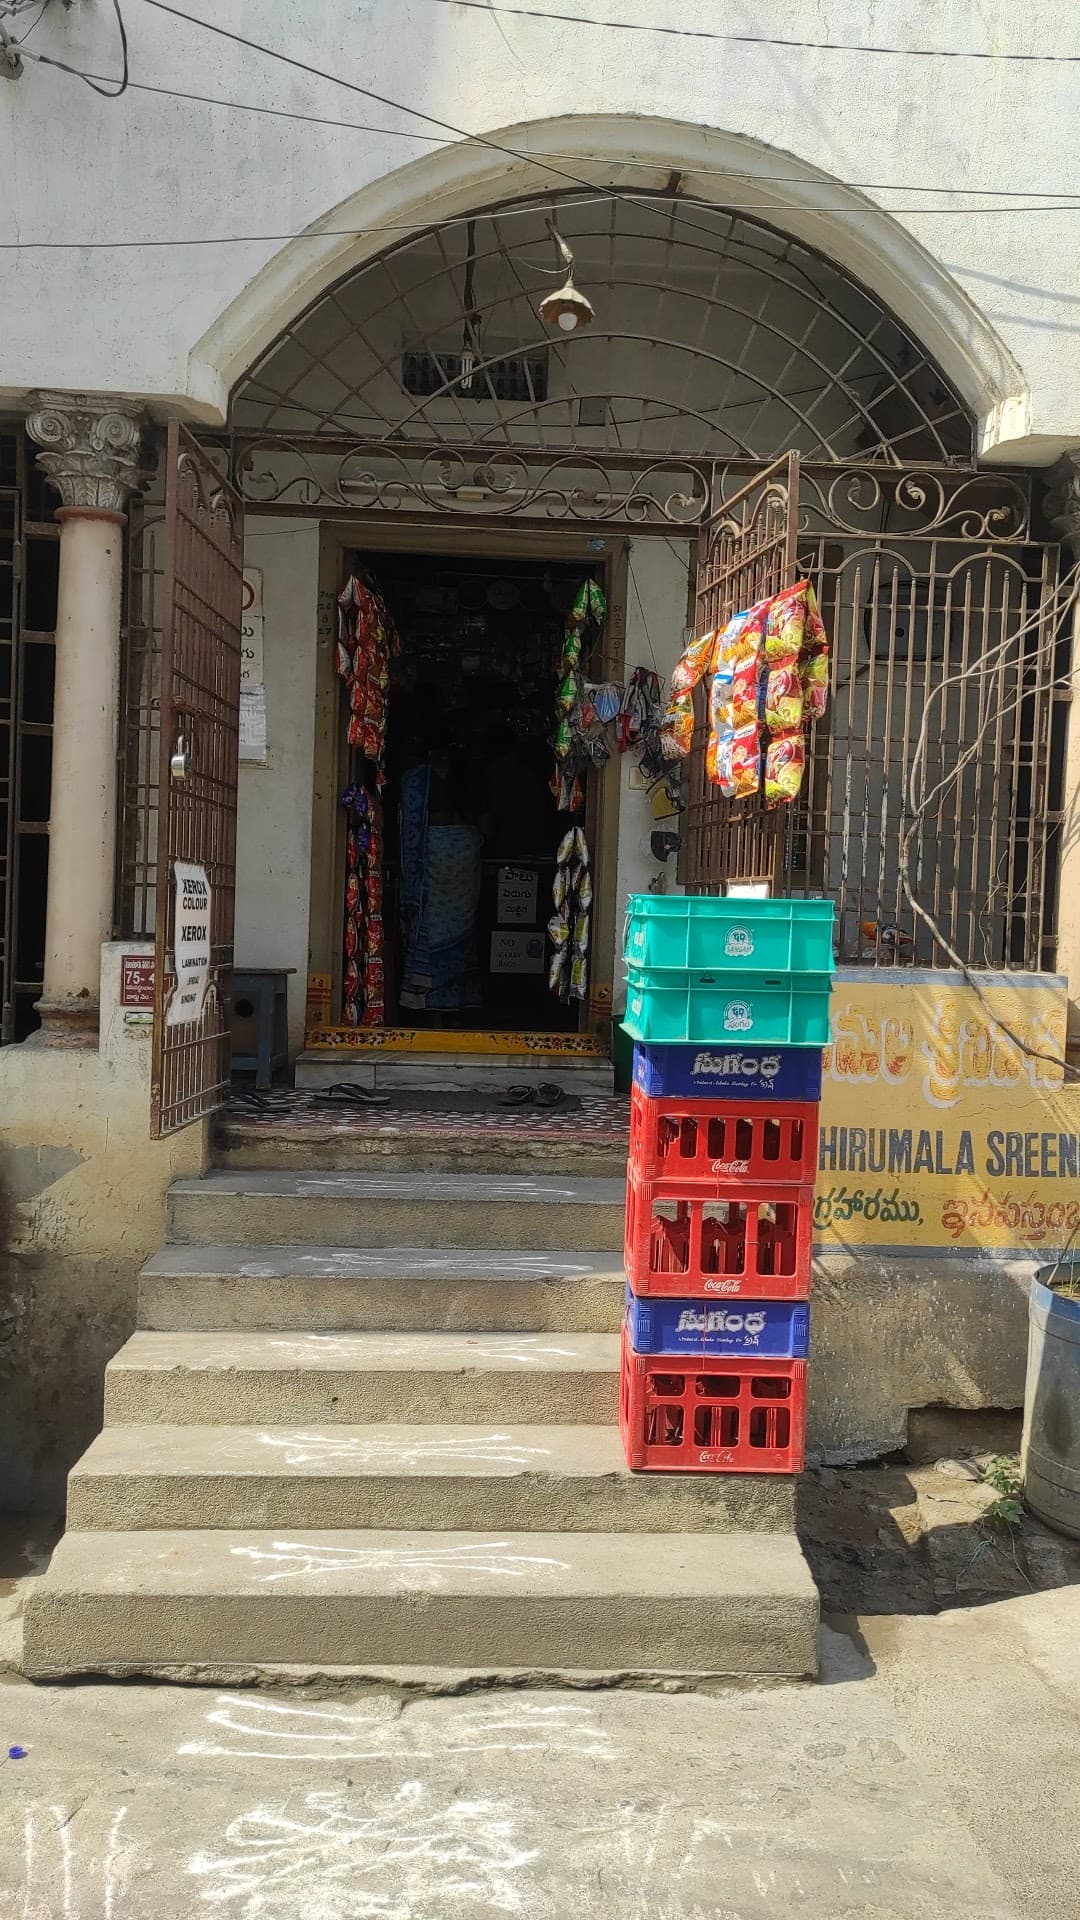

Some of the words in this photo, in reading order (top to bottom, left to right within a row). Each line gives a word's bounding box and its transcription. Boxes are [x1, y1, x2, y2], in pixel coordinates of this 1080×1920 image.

[182, 878, 208, 896] XEROX
[183, 897, 208, 911] COLOUR
[181, 925, 207, 942] XEROX
[501, 938, 515, 948] NO
[181, 956, 208, 969] LAMINATION
[818, 1126, 976, 1176] HIRUMALA
[986, 1130, 1080, 1178] SREEN
[813, 1187, 924, 1231] గ్రహారము,
[703, 1279, 741, 1293] Coca-Cola
